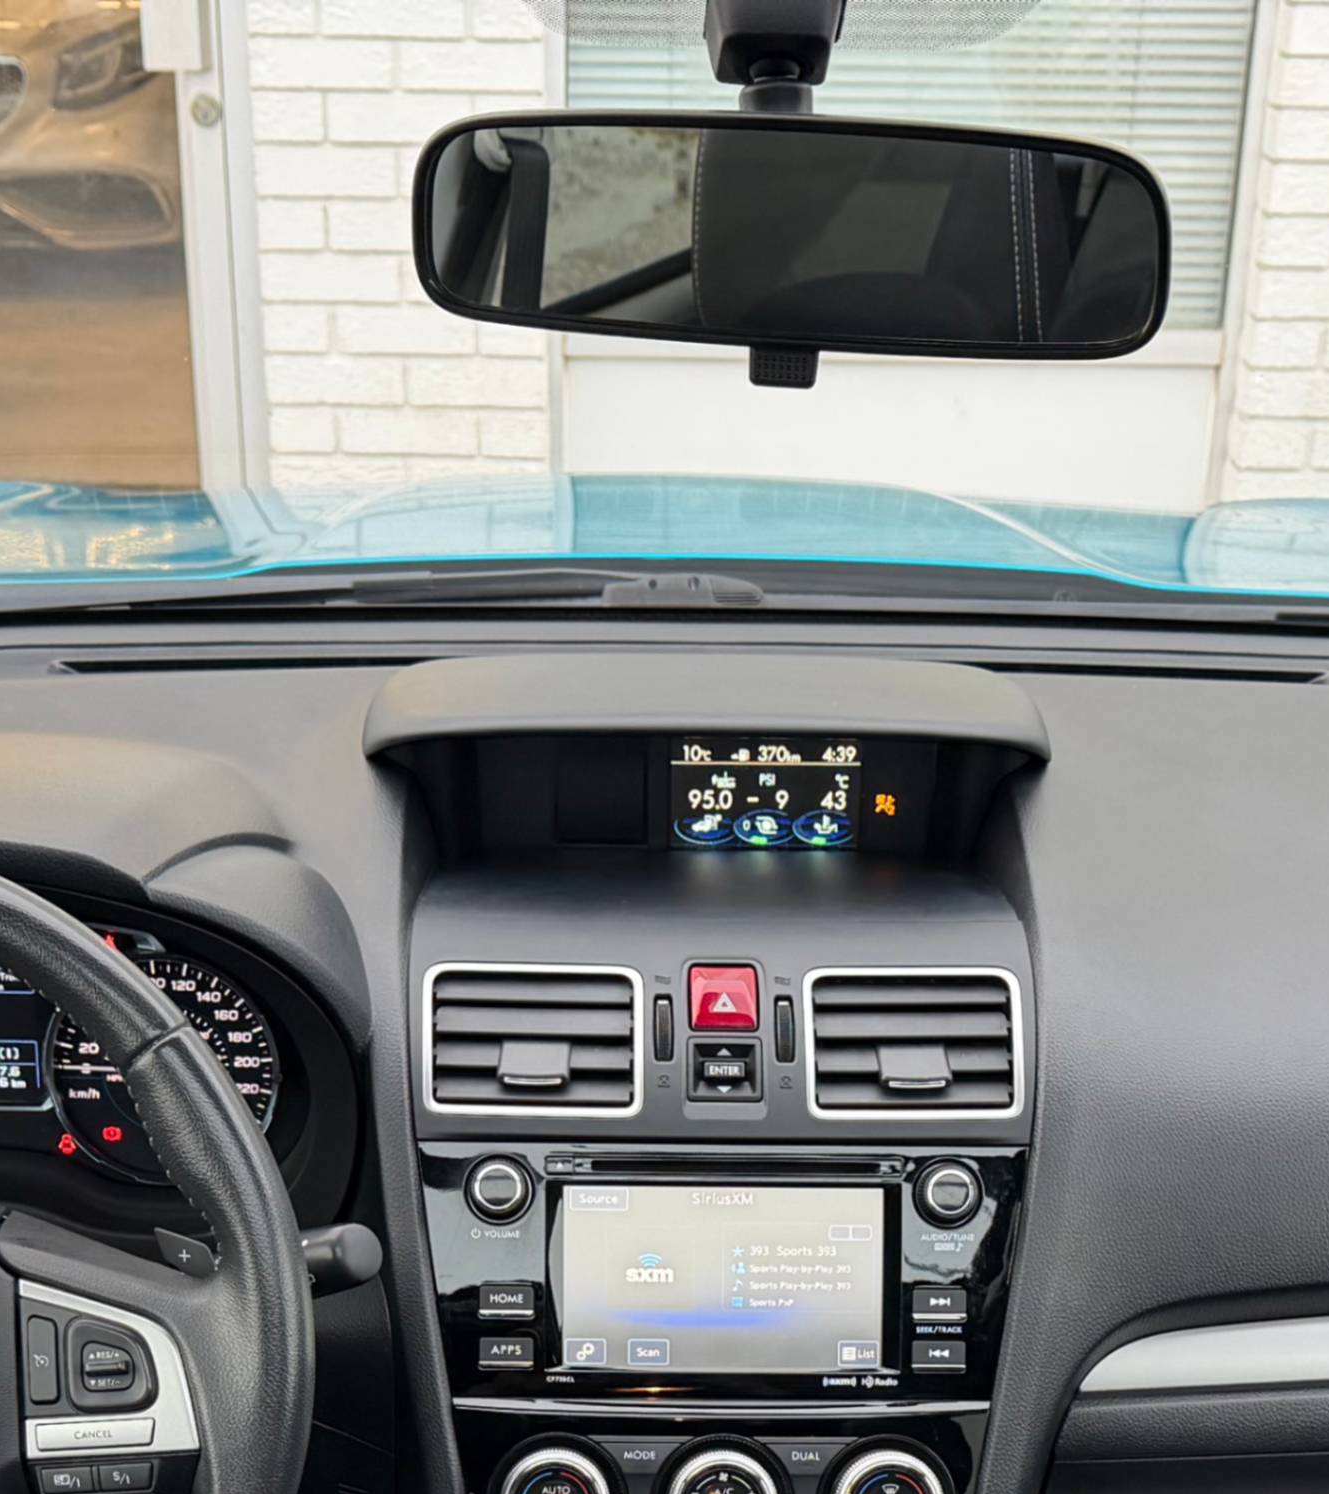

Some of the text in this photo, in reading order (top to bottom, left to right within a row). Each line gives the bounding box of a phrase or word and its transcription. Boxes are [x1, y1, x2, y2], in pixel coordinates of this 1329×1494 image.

[822, 745, 857, 762] 4:39
[688, 789, 733, 810] 95.0
[775, 789, 789, 810] 9
[820, 790, 847, 810] 43
[171, 979, 196, 991] 120
[196, 991, 221, 1003] 140
[214, 1009, 239, 1021] 160
[227, 1031, 253, 1043] 180
[78, 1042, 100, 1054] 20
[233, 1056, 260, 1068] 200
[708, 1064, 740, 1076] ENTER
[68, 1088, 101, 1100] km/h
[579, 1192, 619, 1206] Source
[692, 1191, 754, 1207] SiriusXM
[484, 1229, 521, 1239] VOLUME
[750, 1244, 838, 1259] 393 Sports 393
[625, 1266, 675, 1284] sxm
[750, 1263, 779, 1275] Sports
[750, 1280, 779, 1292] Sports
[489, 1293, 525, 1305] HOME
[916, 1325, 963, 1335] SEEK/TRACK
[490, 1344, 523, 1356] APPS
[636, 1346, 661, 1359] Scan
[858, 1348, 876, 1360] List
[74, 1429, 114, 1441] CANCEL
[623, 1448, 657, 1462] MODE
[791, 1450, 821, 1462] DUAL
